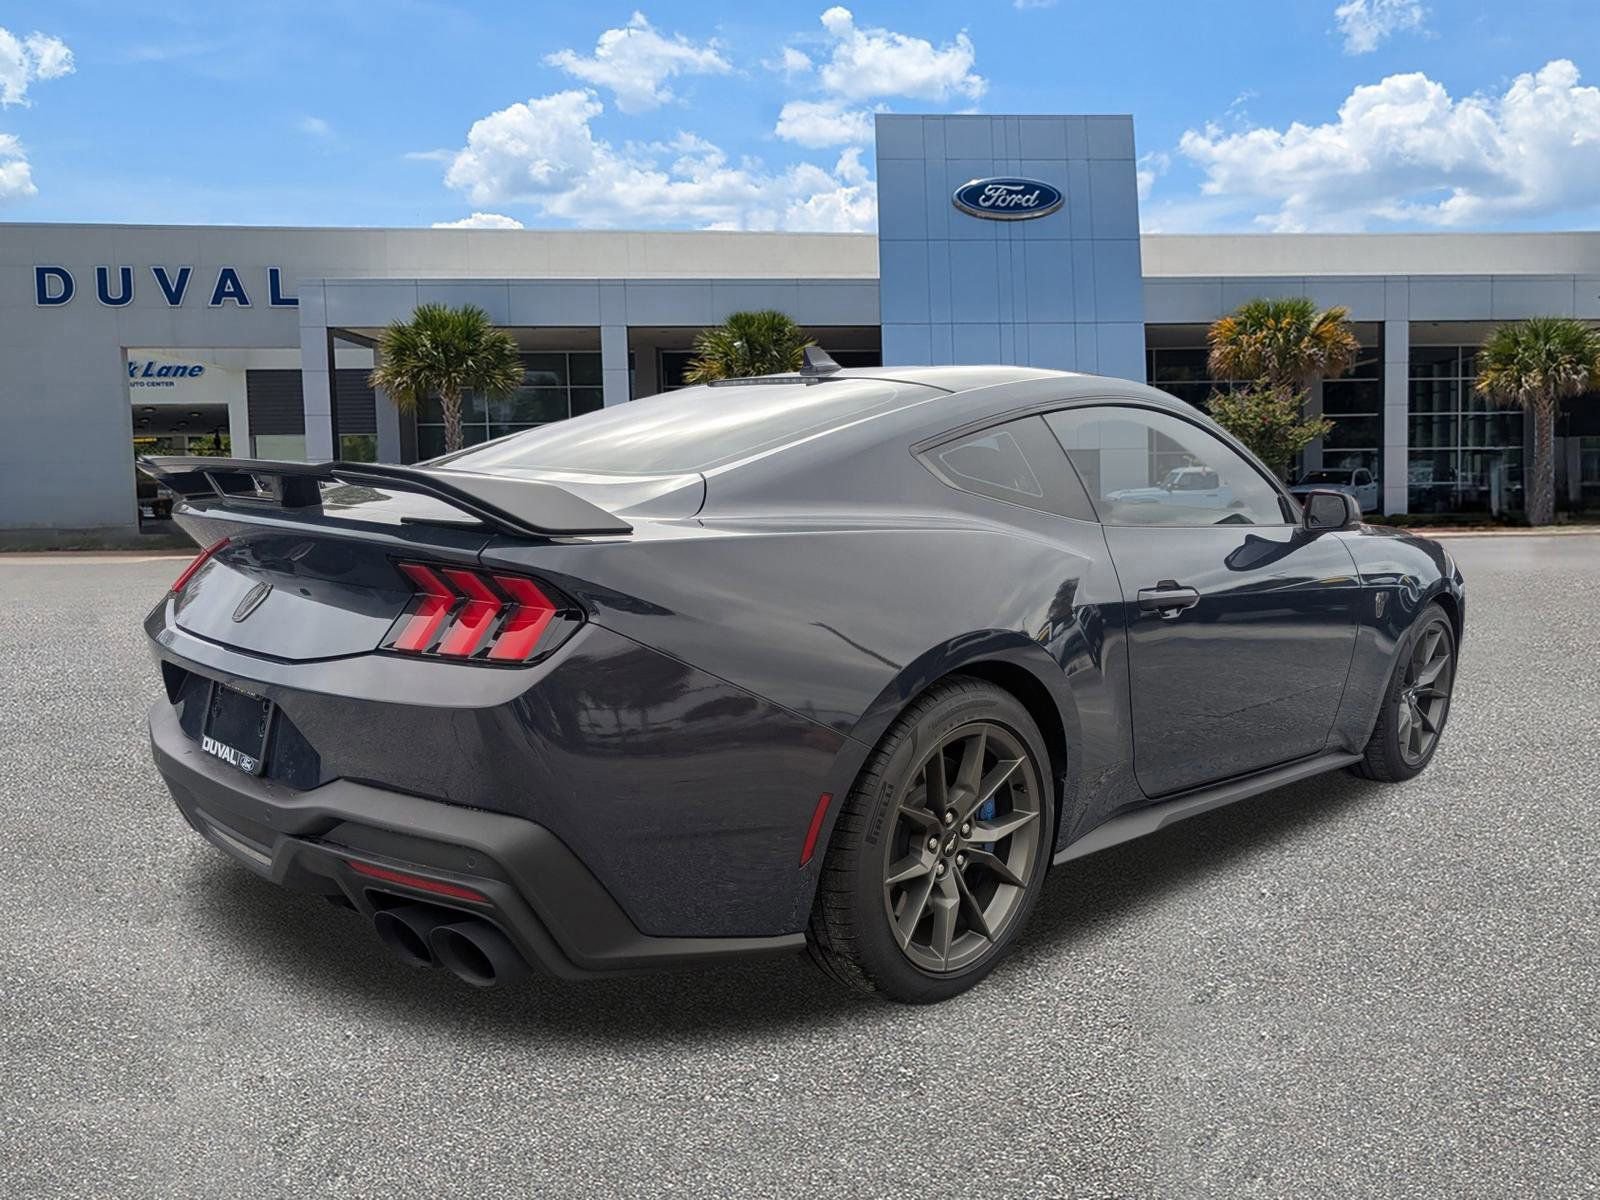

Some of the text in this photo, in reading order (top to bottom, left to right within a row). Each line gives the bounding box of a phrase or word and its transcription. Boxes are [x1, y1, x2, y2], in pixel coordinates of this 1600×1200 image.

[978, 184, 1040, 207] Ford
[34, 265, 299, 308] DUVAL
[141, 361, 204, 378] Lane
[202, 735, 237, 766] DUVAL
